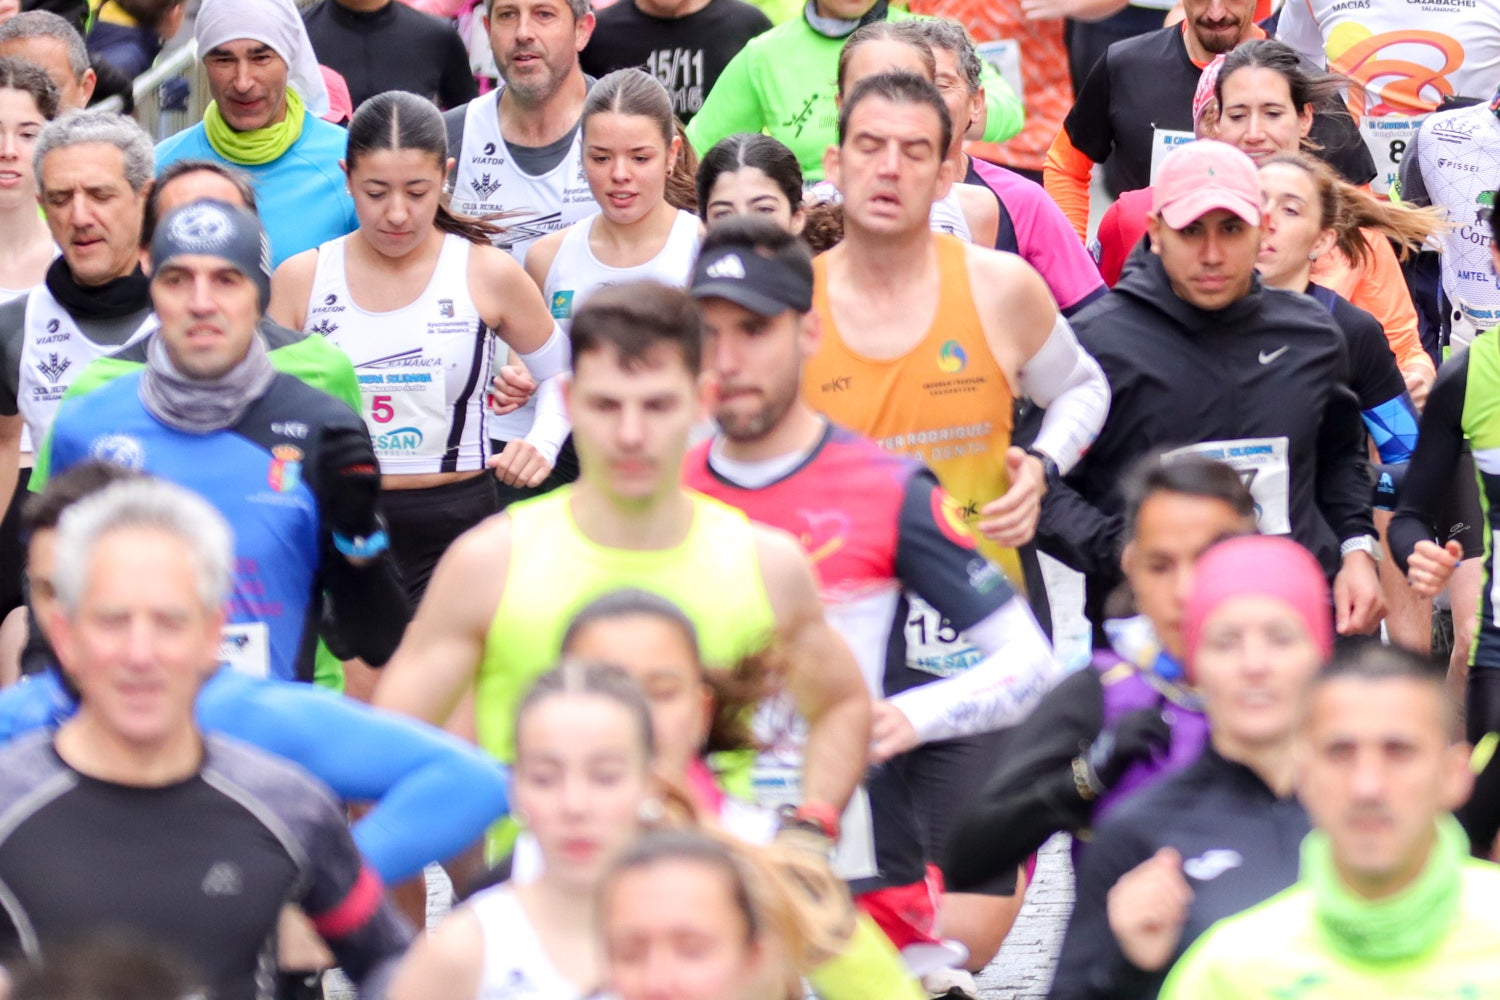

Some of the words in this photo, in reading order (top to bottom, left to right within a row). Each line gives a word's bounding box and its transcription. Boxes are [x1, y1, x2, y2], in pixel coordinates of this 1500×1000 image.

[647, 47, 704, 88] 15/11
[472, 157, 504, 165] VIATOR
[1447, 162, 1479, 172] PISSEI
[1457, 270, 1488, 282] AMTEL
[36, 333, 71, 345] VIATOR
[387, 373, 432, 383] SOLIDARIA
[372, 396, 394, 423] 5
